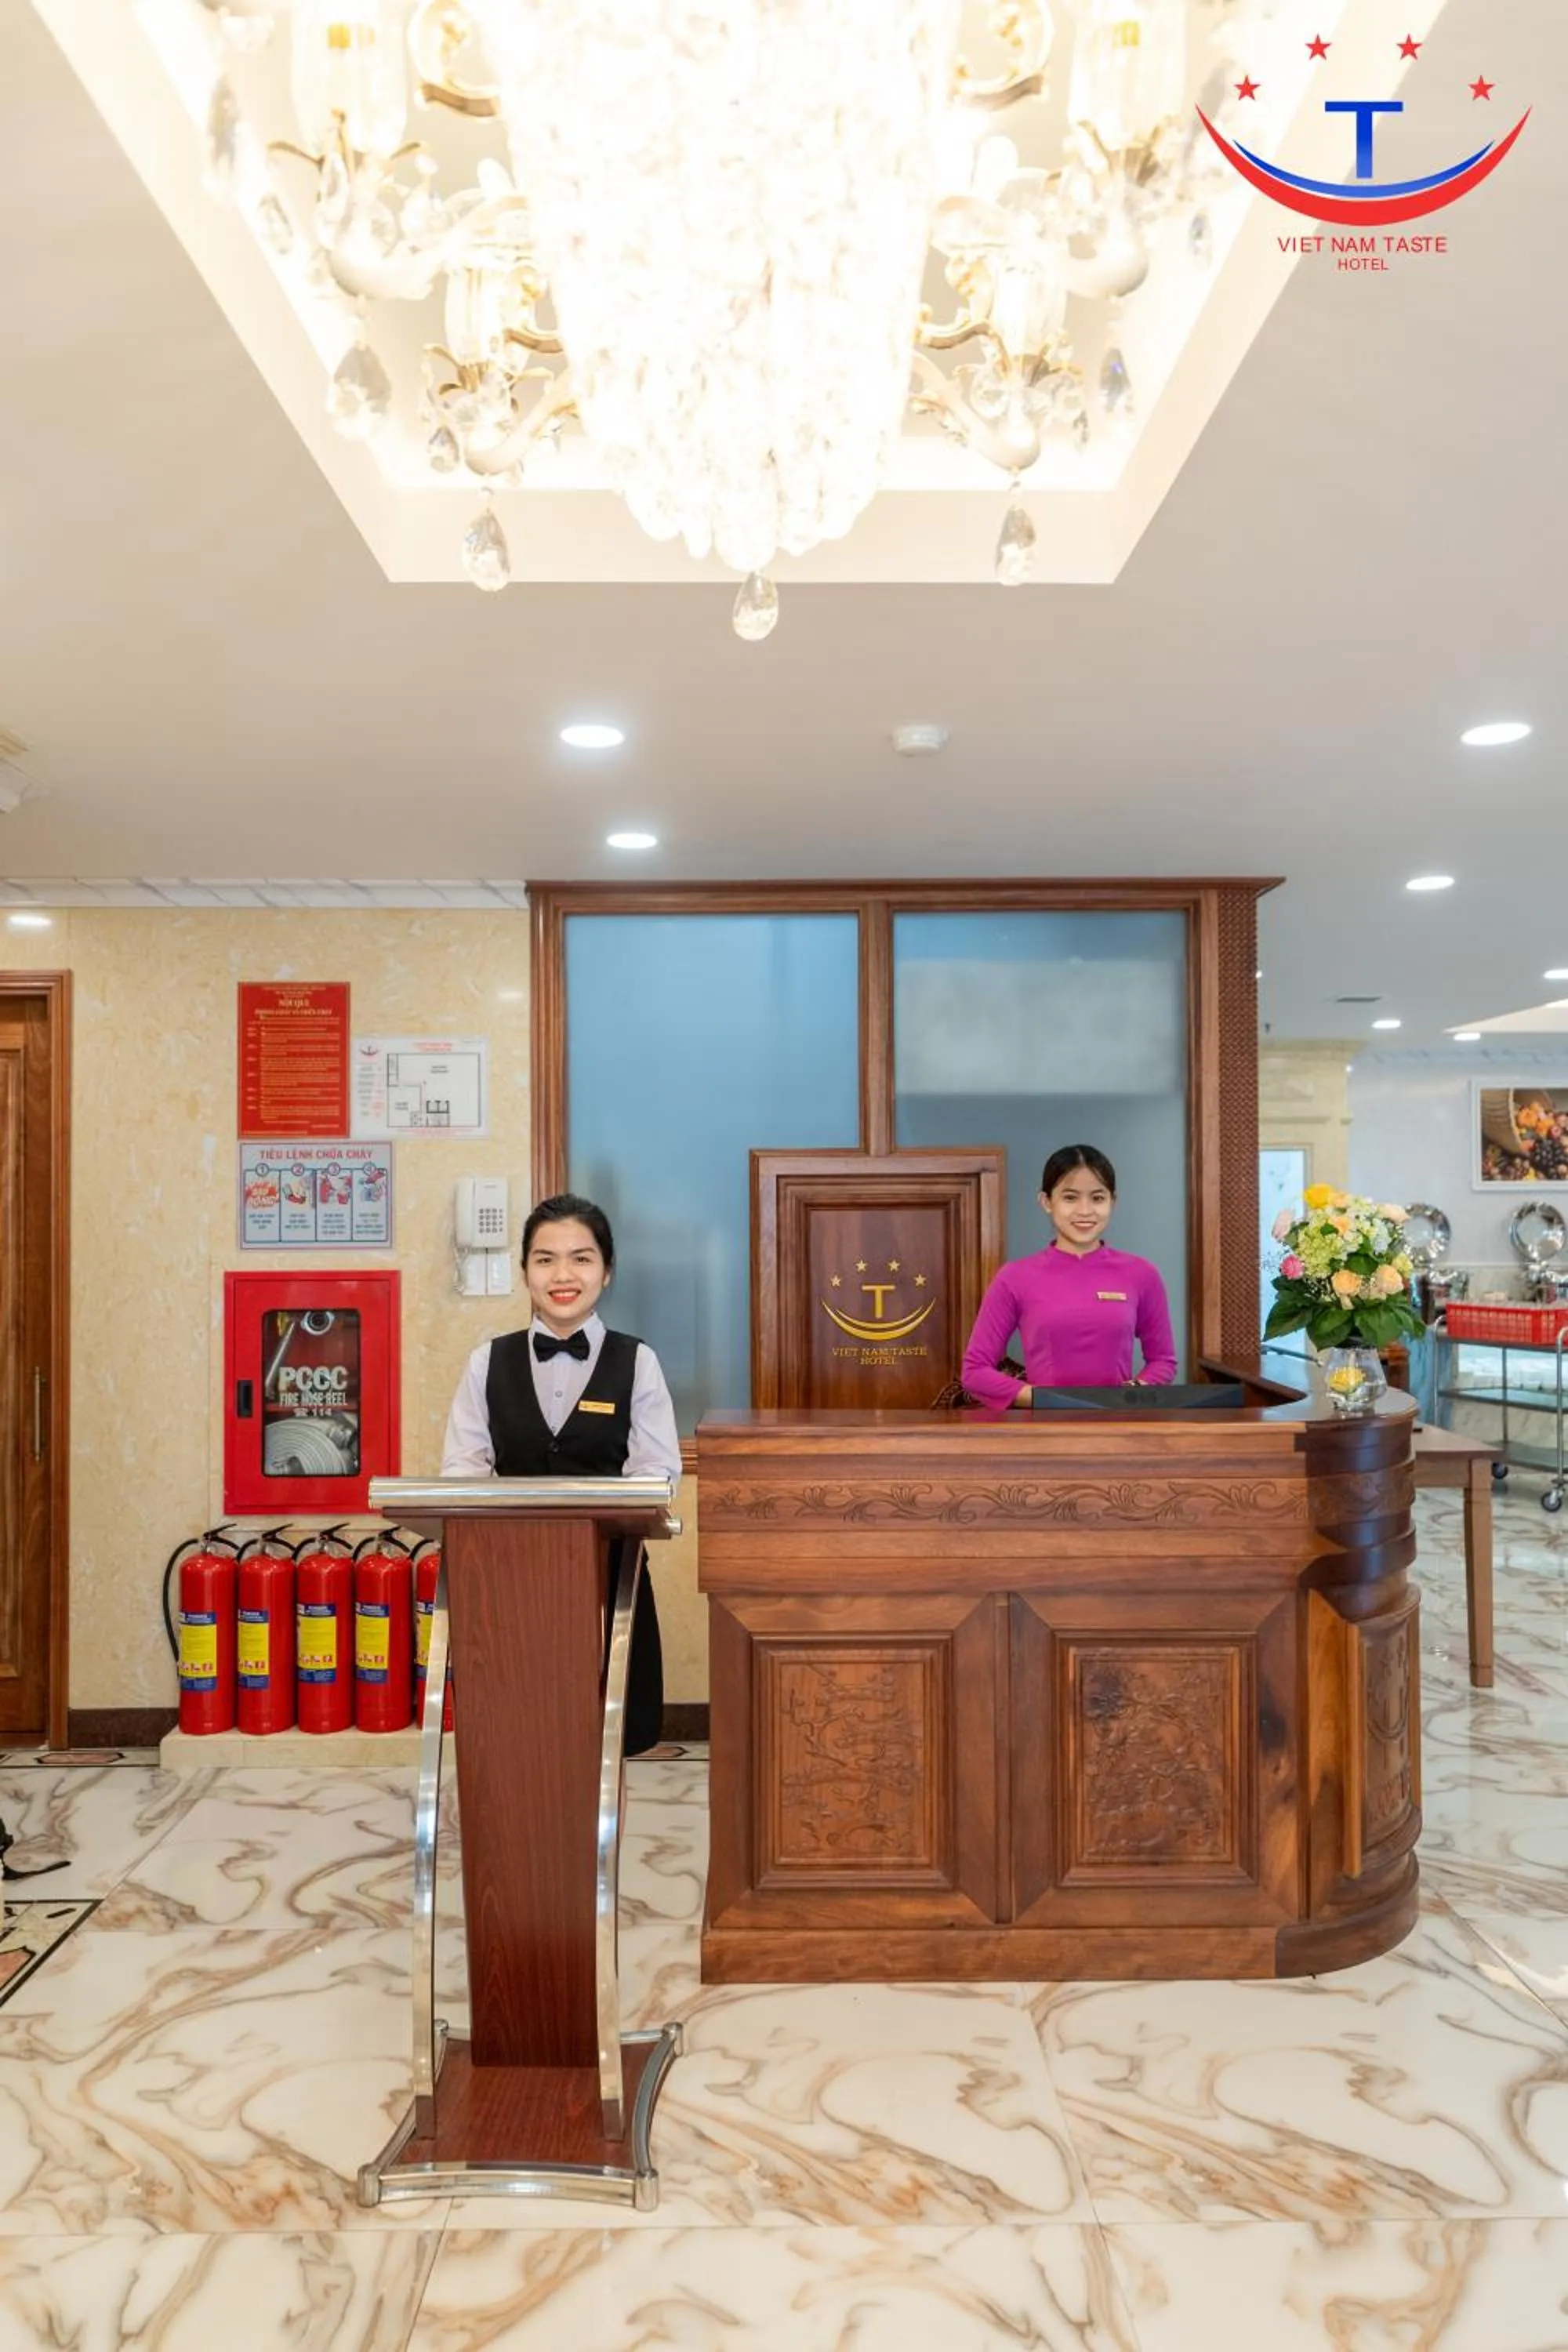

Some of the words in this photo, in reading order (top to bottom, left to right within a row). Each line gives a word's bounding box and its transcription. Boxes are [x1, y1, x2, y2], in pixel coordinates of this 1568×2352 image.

[862, 1285, 895, 1319] T
[832, 1348, 859, 1356] VIET
[892, 1347, 927, 1356] TASTE
[278, 1366, 348, 1391] PCCC
[280, 1392, 299, 1406] FIRE
[301, 1392, 324, 1406] HOSE
[325, 1392, 347, 1406] REEL
[312, 1407, 332, 1416] 114
